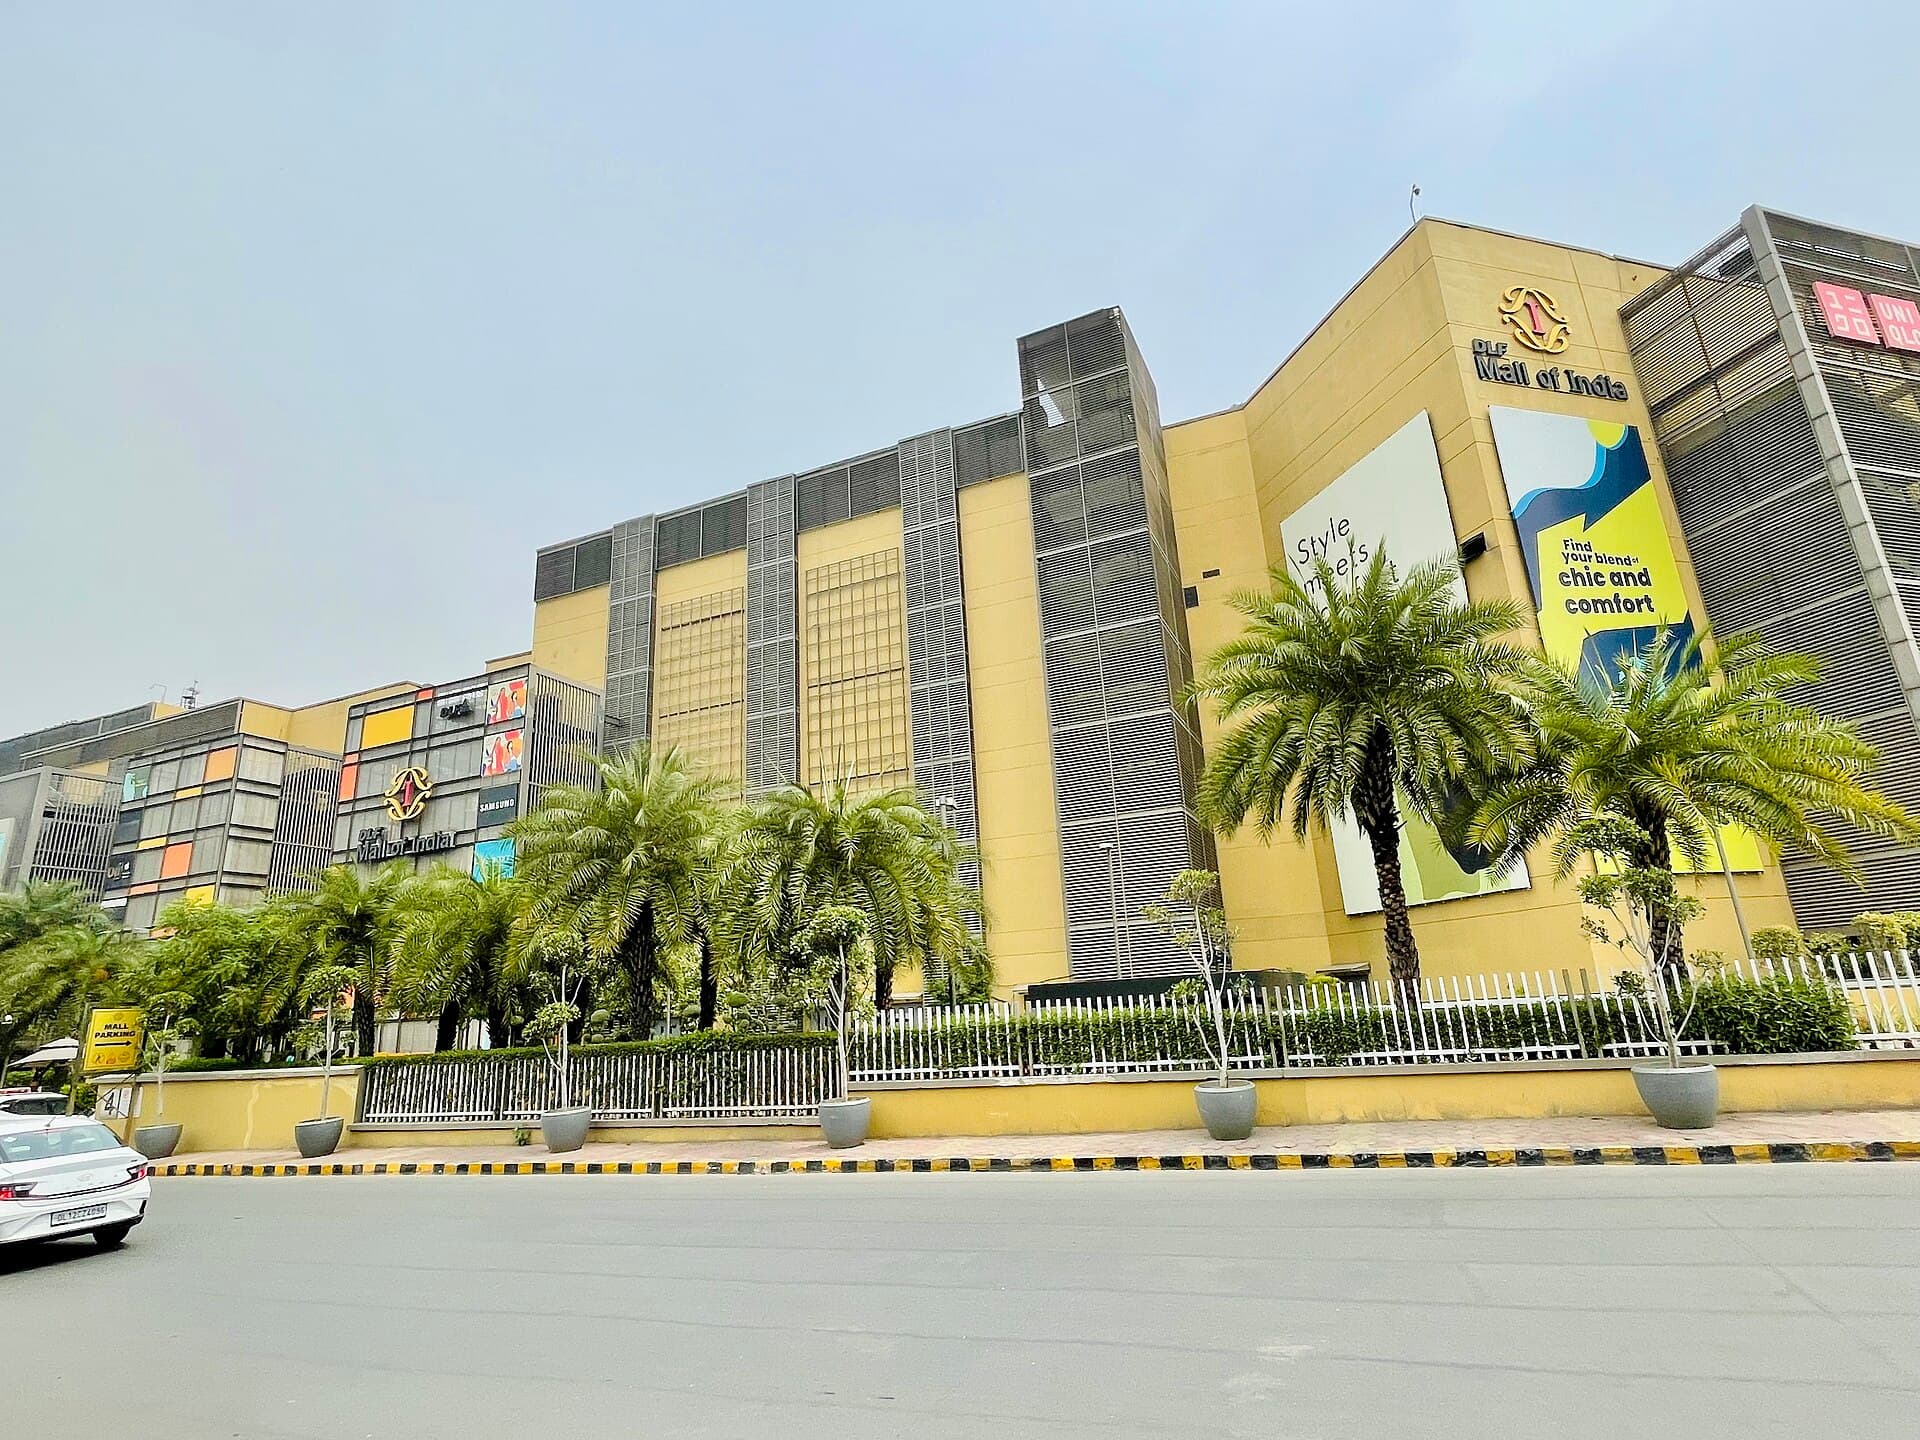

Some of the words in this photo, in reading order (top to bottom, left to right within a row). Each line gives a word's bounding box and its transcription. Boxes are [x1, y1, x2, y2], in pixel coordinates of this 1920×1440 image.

[1878, 302, 1915, 325] UNI
[1472, 339, 1508, 356] DLF
[1474, 355, 1531, 386] Mall
[1536, 366, 1561, 391] of
[1564, 369, 1629, 401] India
[1297, 516, 1351, 566] Style
[1563, 538, 1593, 553] Find
[1561, 550, 1593, 565] your
[1595, 552, 1632, 567] blend
[1558, 565, 1606, 587] chic
[1609, 567, 1653, 587] and
[1565, 593, 1655, 615] comfort
[479, 798, 515, 813] SAMSUNG
[358, 827, 384, 841] DLF
[357, 839, 388, 863] Mall
[390, 837, 408, 856] of
[410, 830, 453, 854] India
[94, 1030, 136, 1039] PARKING
